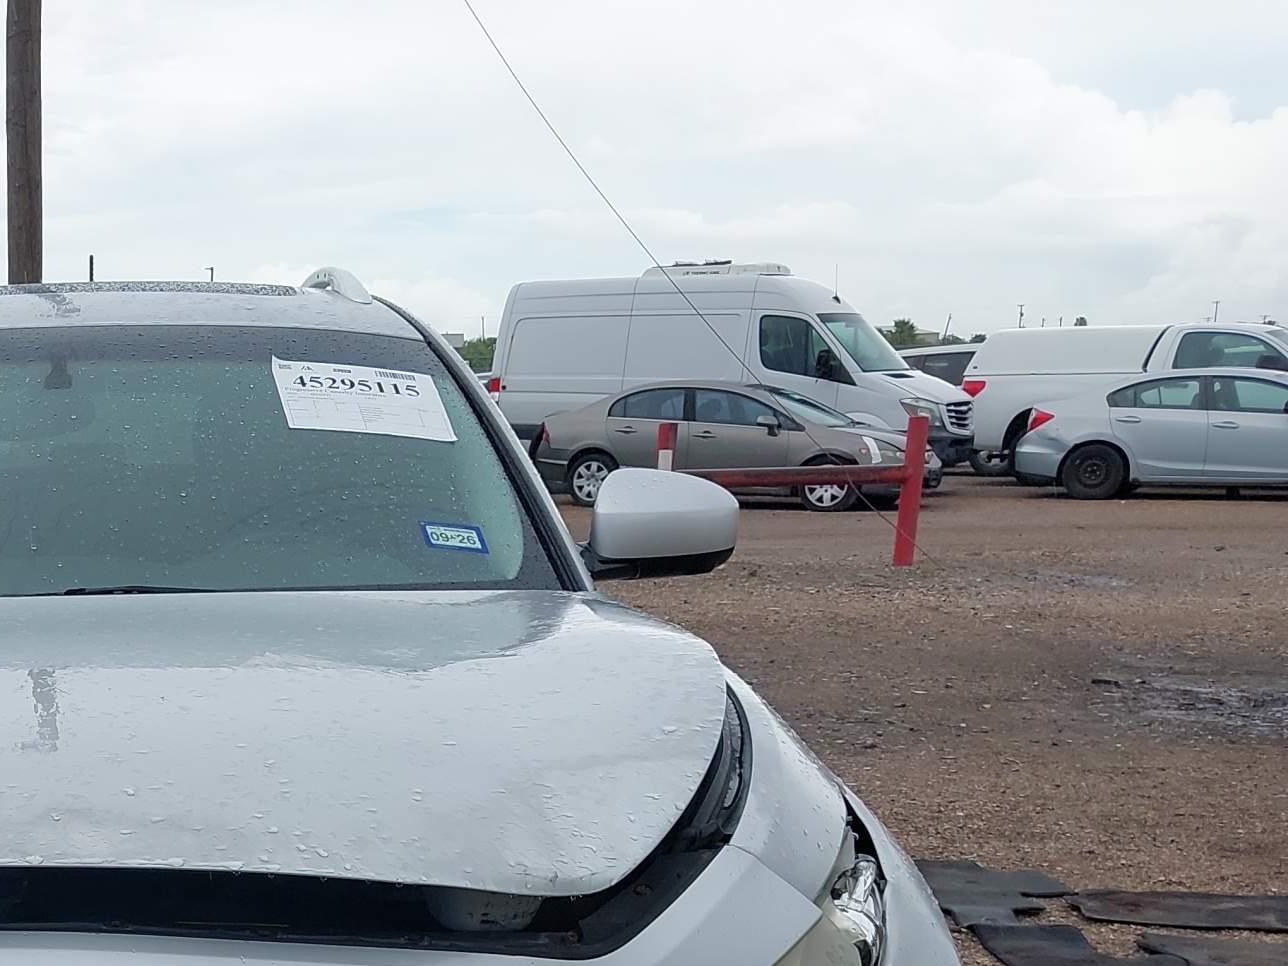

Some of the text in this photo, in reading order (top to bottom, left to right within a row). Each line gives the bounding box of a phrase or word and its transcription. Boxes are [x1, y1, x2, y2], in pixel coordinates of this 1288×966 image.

[293, 375, 421, 397] 45295115
[430, 531, 477, 546] 09 26
